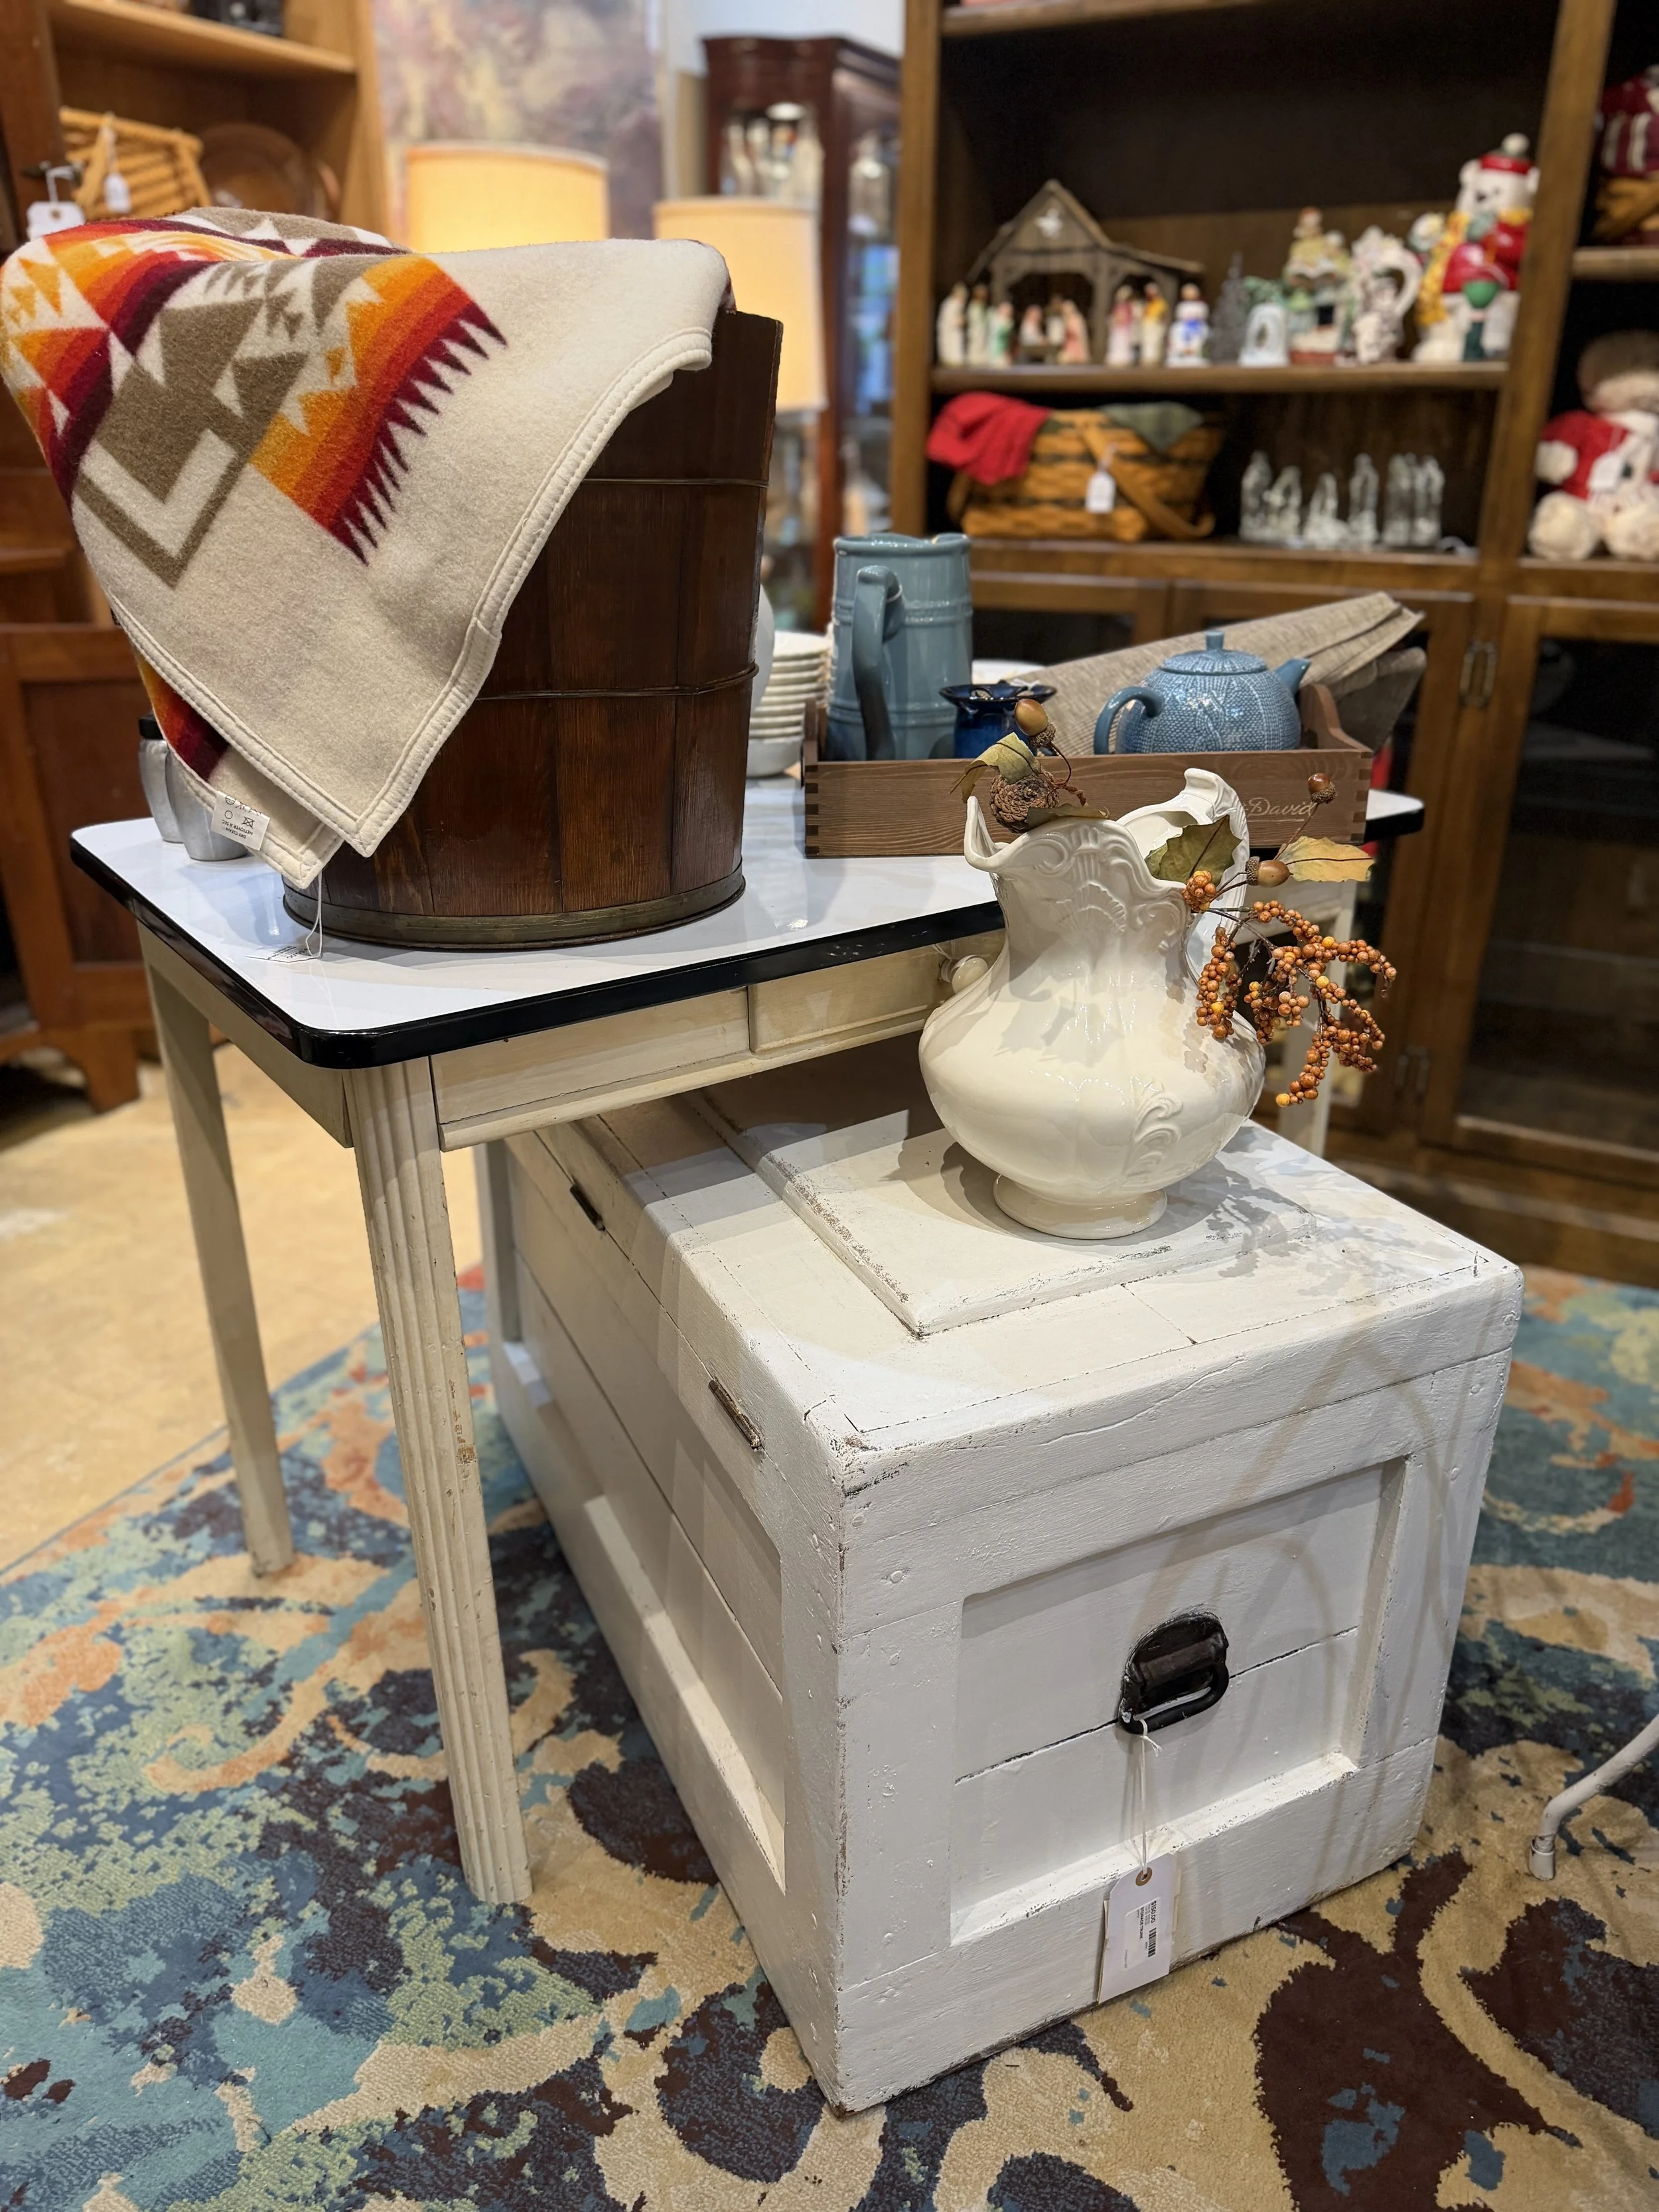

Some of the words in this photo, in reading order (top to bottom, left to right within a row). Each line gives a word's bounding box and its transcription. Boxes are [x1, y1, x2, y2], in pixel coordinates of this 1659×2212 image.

[1248, 797, 1317, 817] David
[226, 827, 238, 836] CLEAN
[234, 825, 253, 836] NETTOYER
